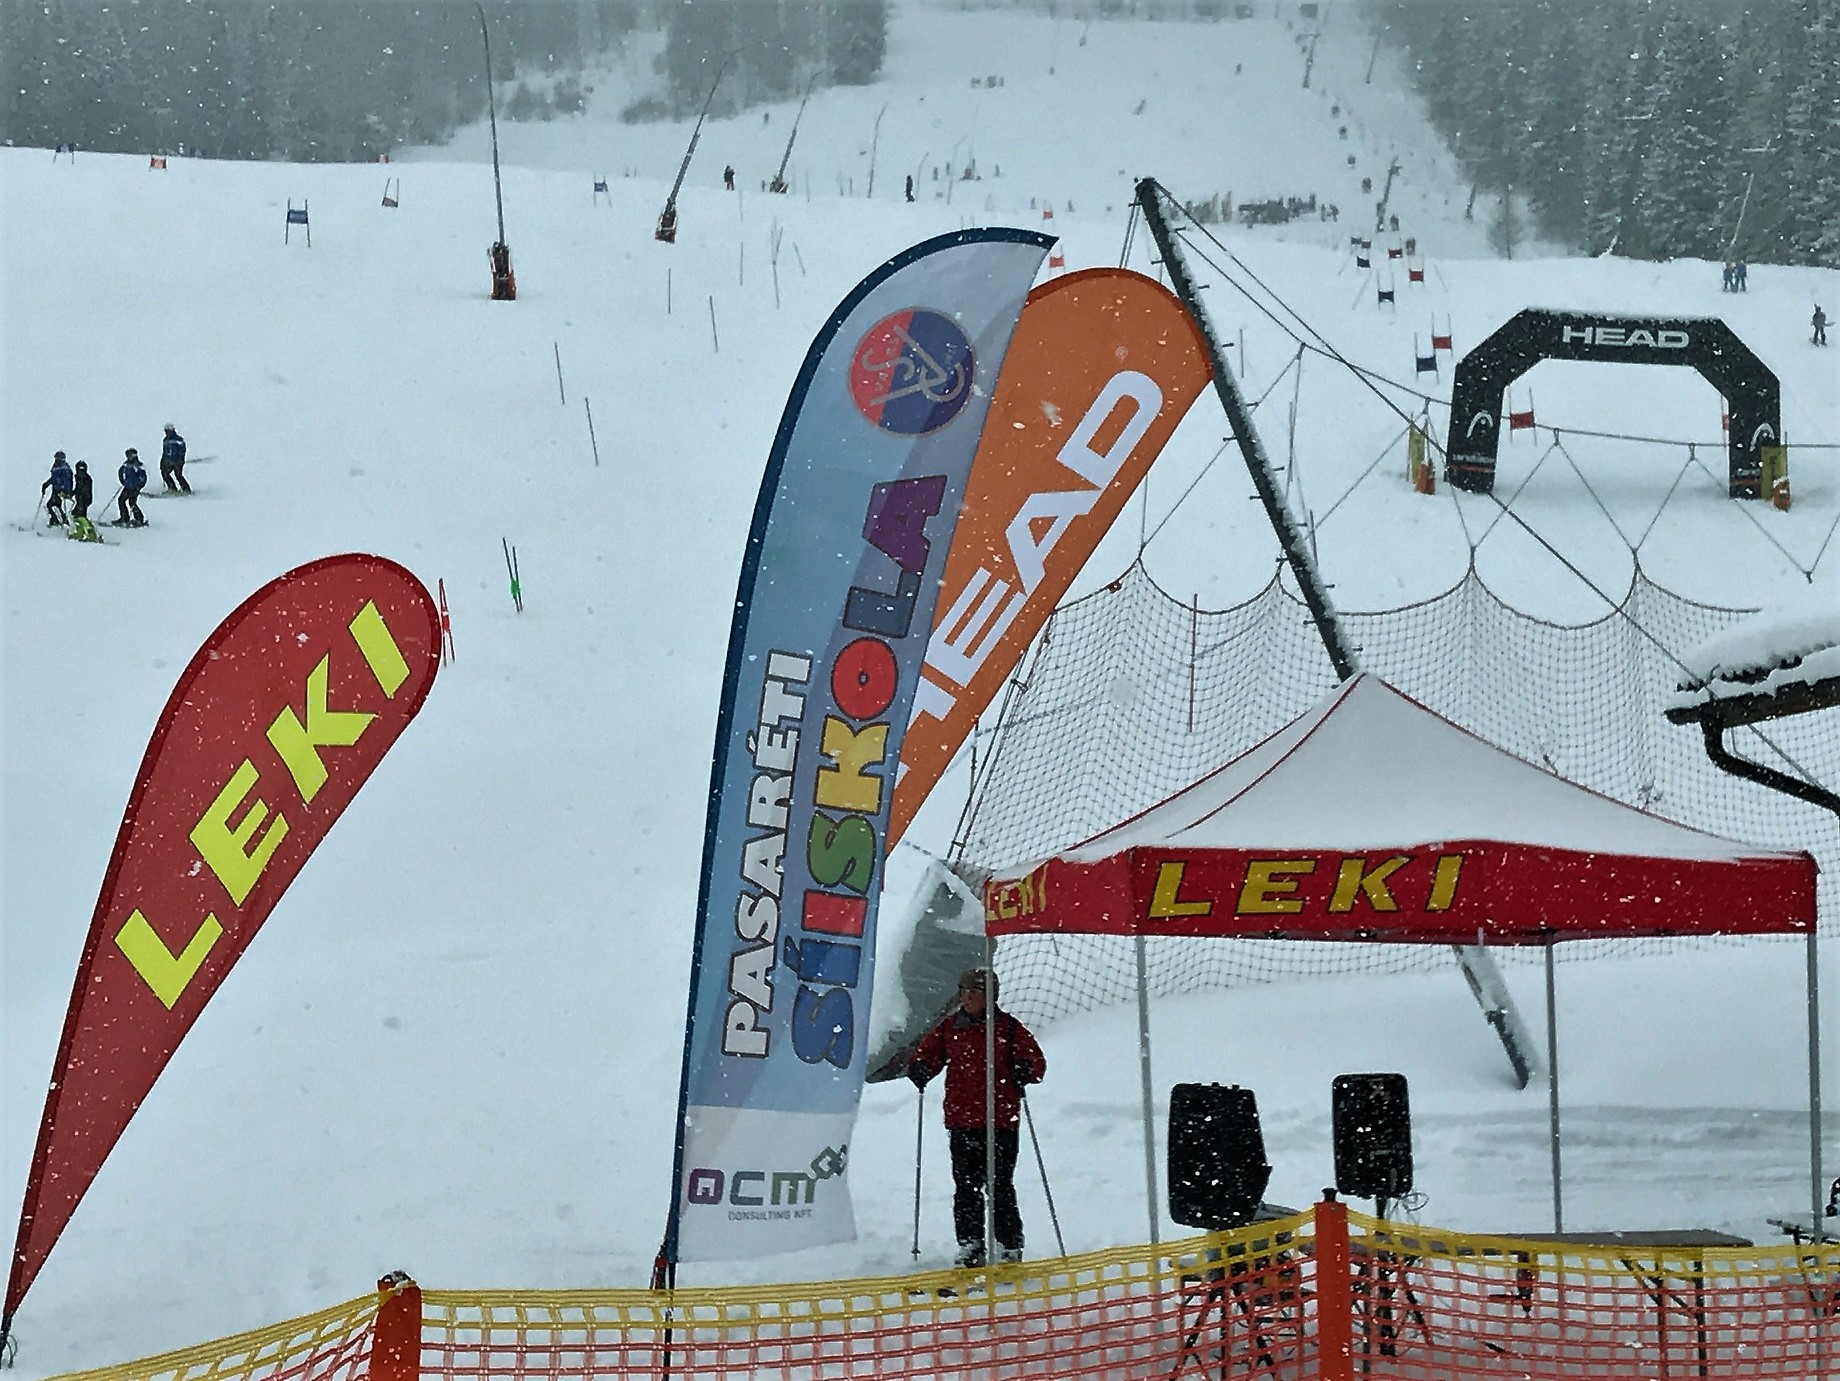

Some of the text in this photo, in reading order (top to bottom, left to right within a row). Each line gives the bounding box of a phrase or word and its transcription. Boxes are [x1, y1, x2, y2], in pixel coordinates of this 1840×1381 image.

[1562, 325, 1690, 349] HEAD
[113, 598, 411, 1012] LEKI
[721, 648, 813, 1059] PASARÉTI
[790, 474, 948, 1070] SÍISKOLA
[1146, 854, 1463, 919] LEKI
